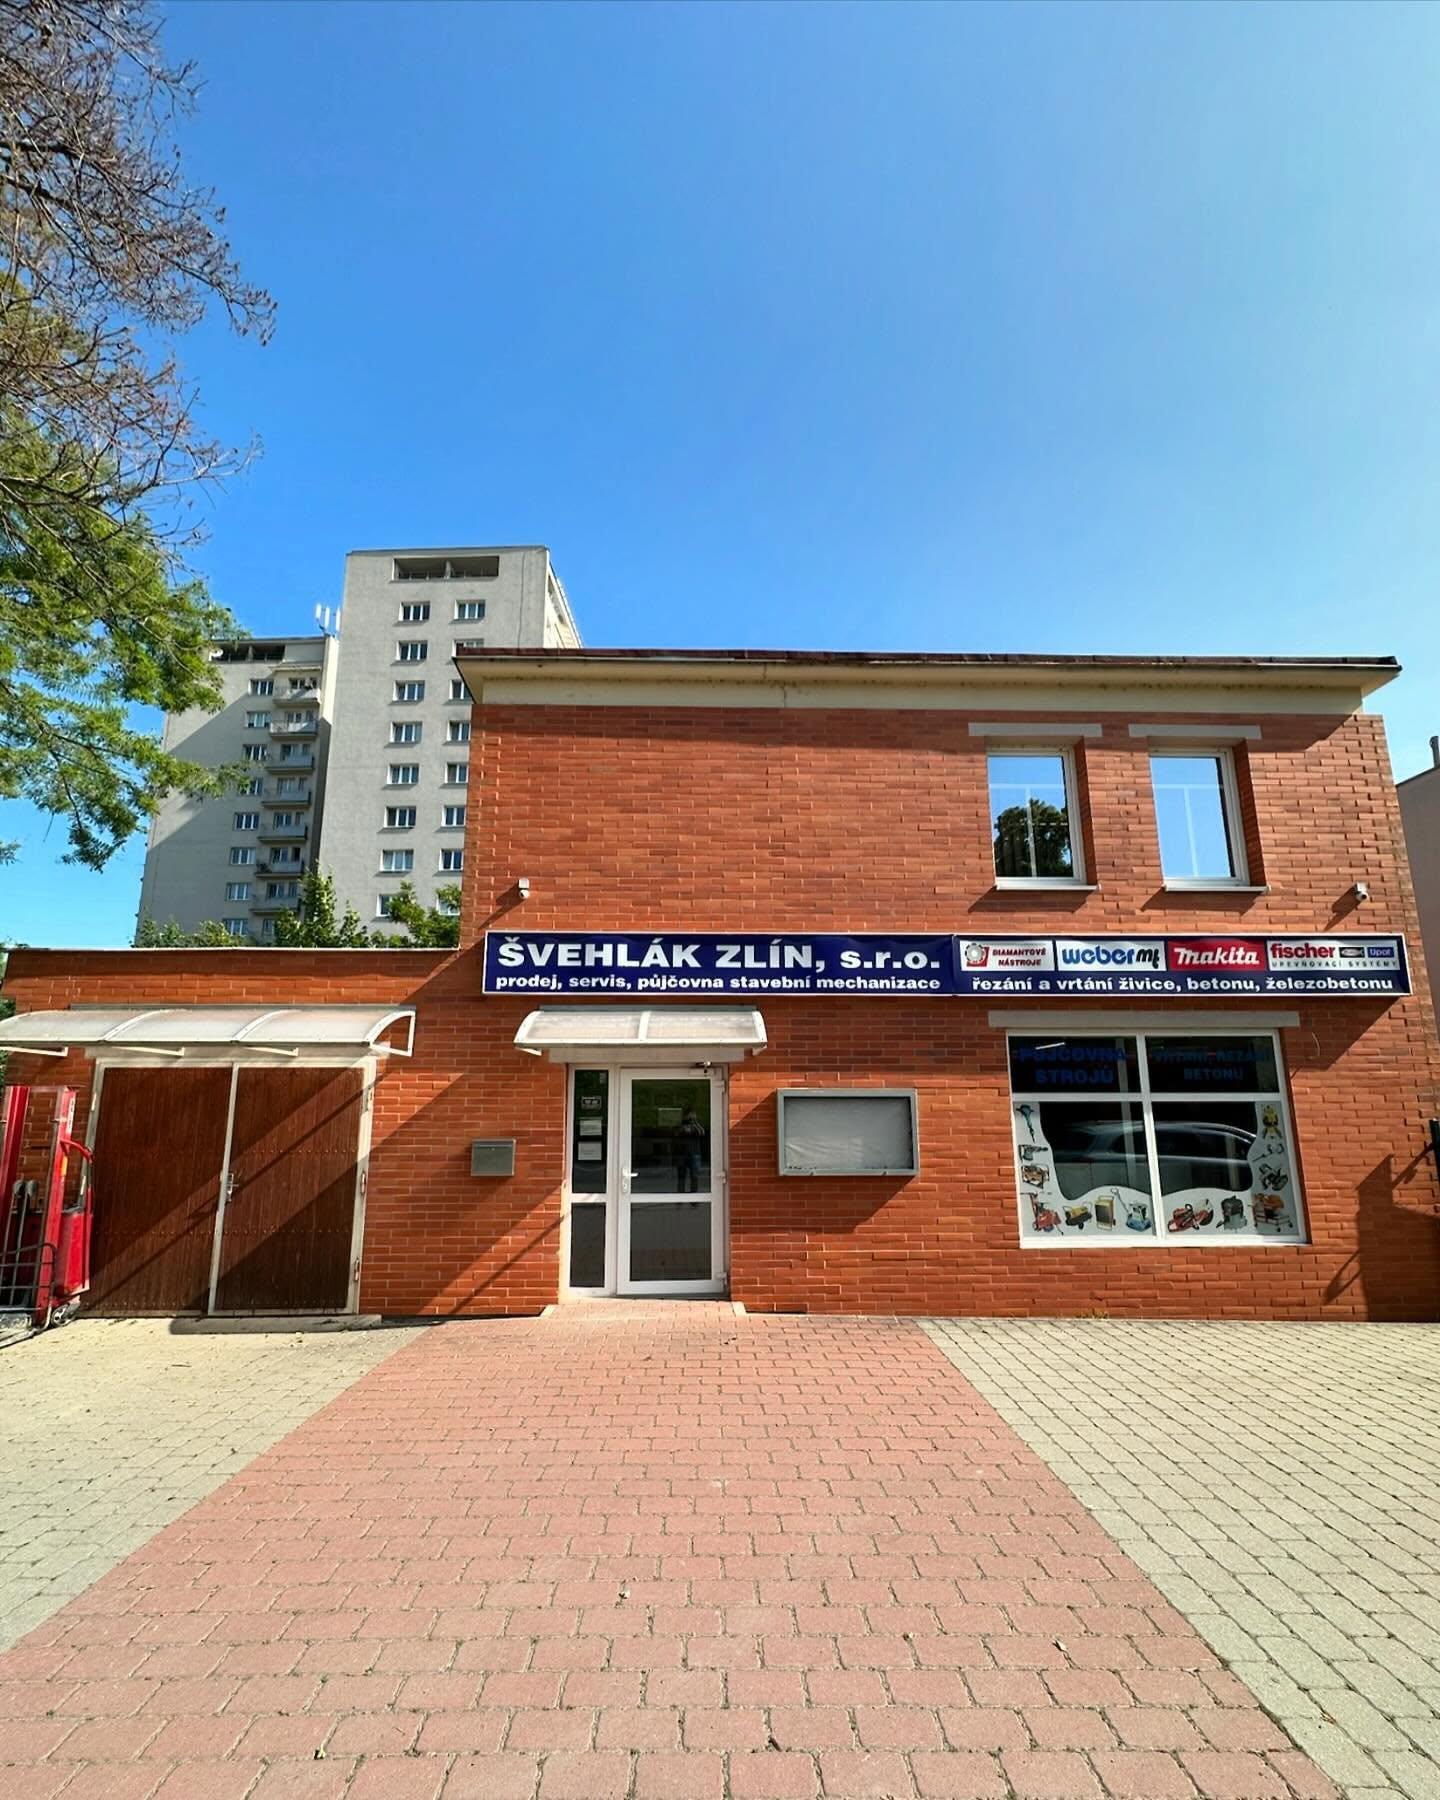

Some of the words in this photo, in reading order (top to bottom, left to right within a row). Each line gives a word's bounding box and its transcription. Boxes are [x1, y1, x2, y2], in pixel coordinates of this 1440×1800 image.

[498, 936, 702, 968] ŠVEHLÁK
[715, 938, 825, 973] ZLÍN,
[840, 950, 940, 970] s.r.o.
[1270, 942, 1336, 959] fischer
[998, 957, 1042, 967] NÁSTROJE
[495, 974, 563, 990] prodej,
[568, 975, 632, 990] servis,
[637, 974, 724, 990] půjčovna
[730, 975, 811, 989] stavební
[816, 976, 941, 990] mechanizace
[972, 976, 1033, 991] řezání
[1038, 980, 1051, 991] a
[1057, 976, 1113, 991] vrtání
[1119, 977, 1182, 993] živice,
[1187, 978, 1261, 993] betonu,
[1266, 976, 1393, 990] železobetonu
